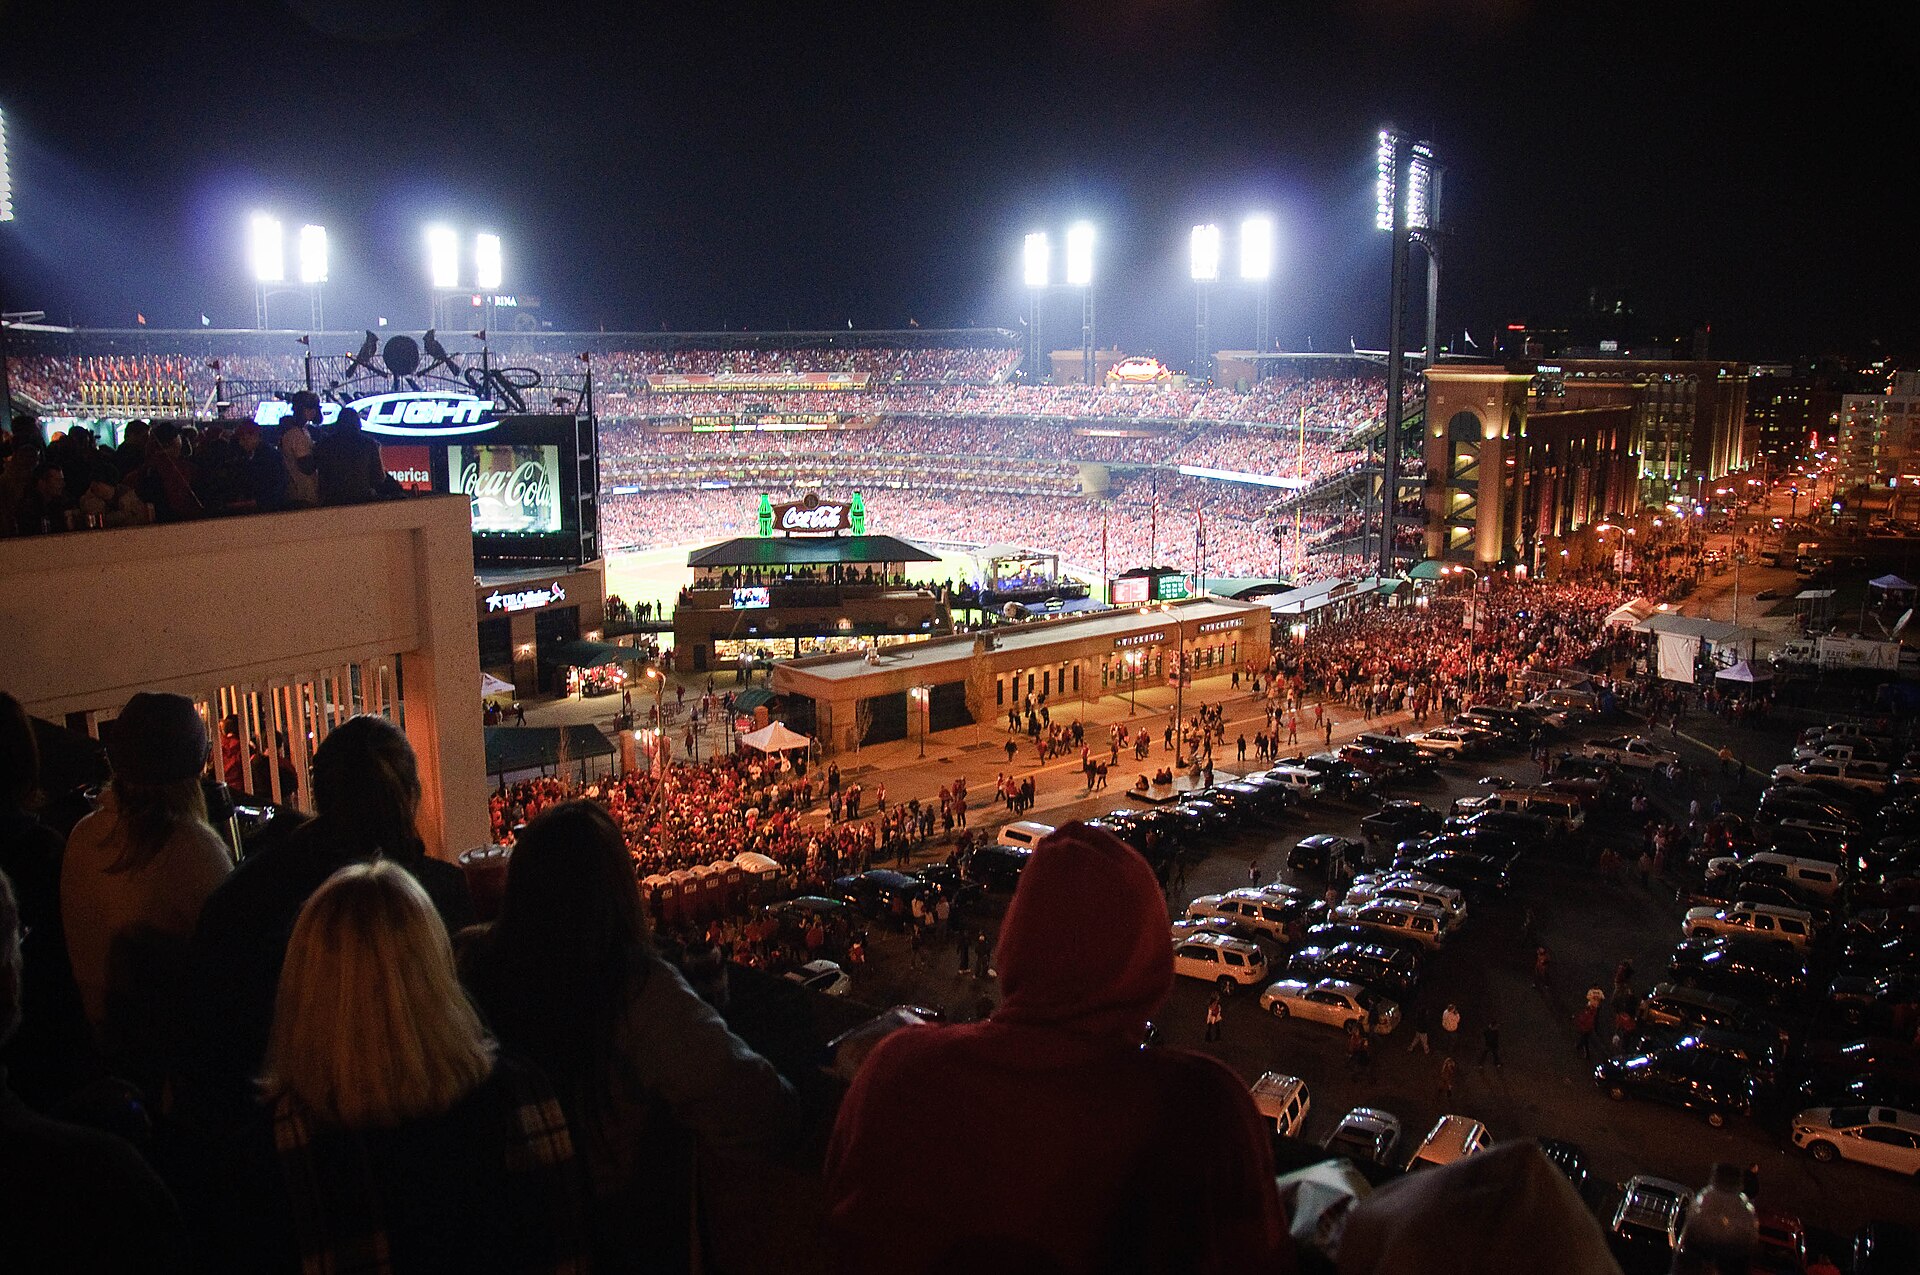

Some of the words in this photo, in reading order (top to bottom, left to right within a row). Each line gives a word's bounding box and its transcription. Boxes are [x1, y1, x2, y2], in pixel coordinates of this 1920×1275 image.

[367, 400, 494, 424] LIGHT
[385, 467, 429, 482] merica
[1205, 619, 1239, 631] TICKETS
[1121, 633, 1160, 646] TICKETS
